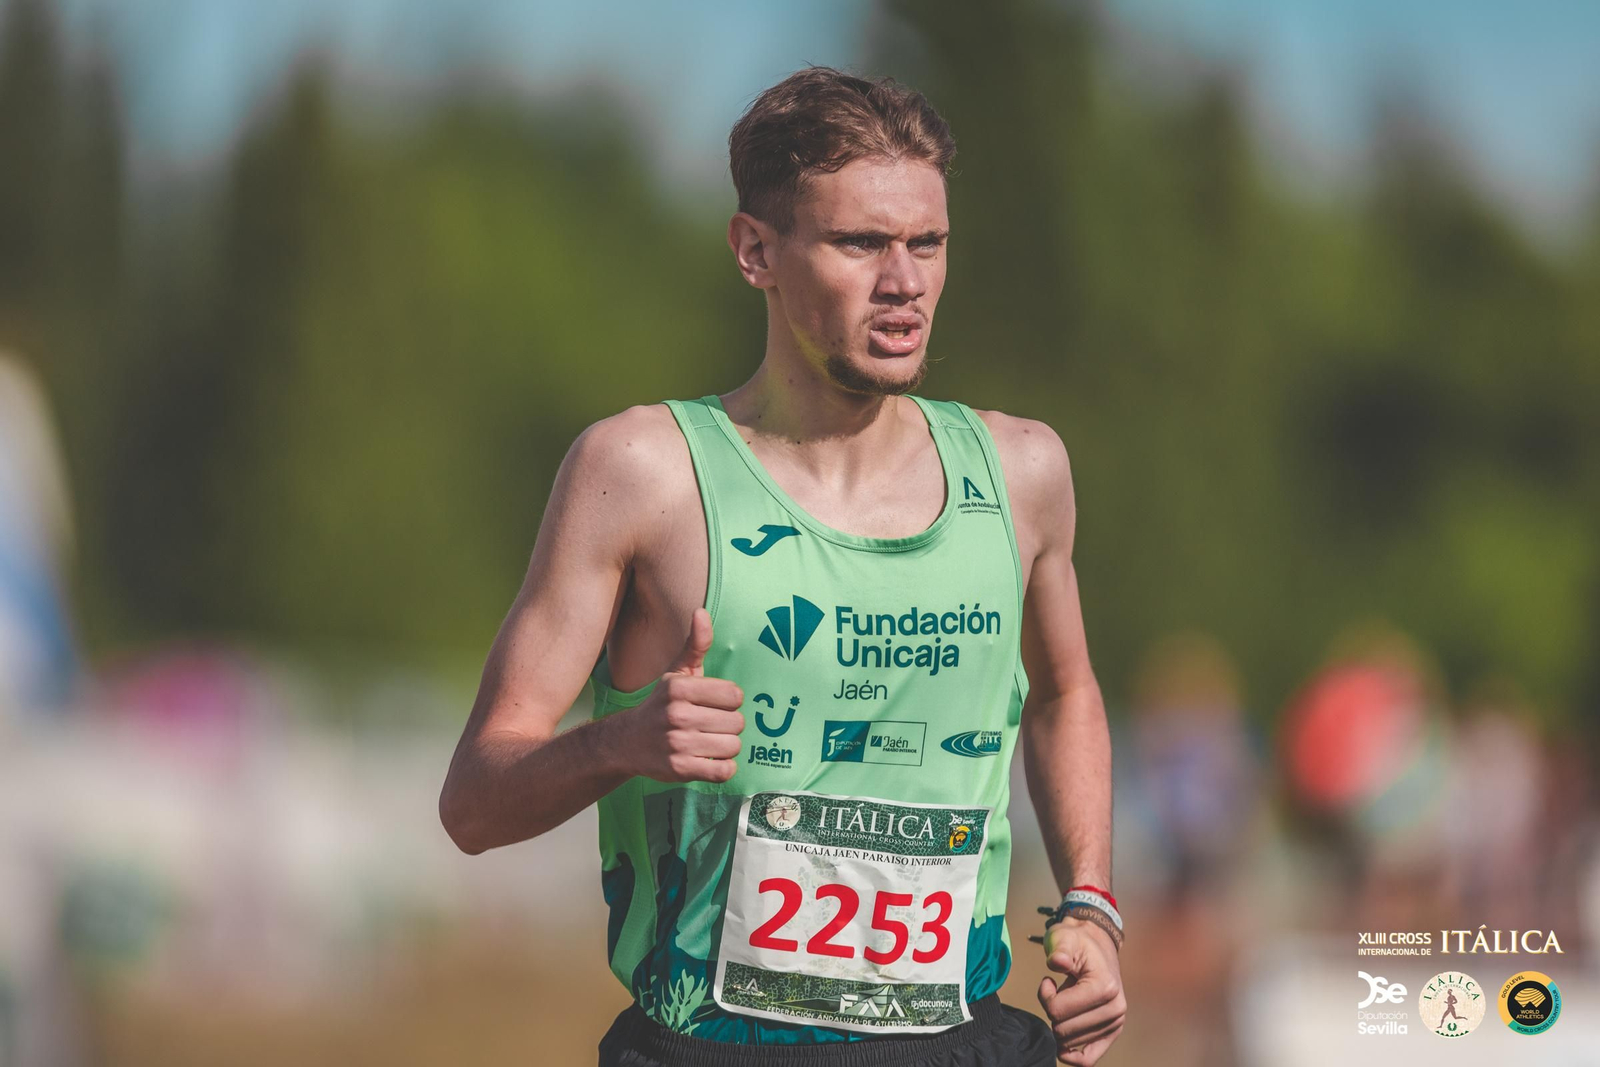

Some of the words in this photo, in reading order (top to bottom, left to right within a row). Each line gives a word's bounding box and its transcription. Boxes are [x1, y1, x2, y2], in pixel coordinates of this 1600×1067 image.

[835, 603, 1000, 636] Fundación
[837, 637, 960, 676] Unicaja
[833, 679, 888, 700] Jaén
[883, 736, 908, 748] Jaén
[818, 803, 935, 840] ITÁLICA
[818, 830, 876, 841] INTERNATIONAL
[879, 836, 902, 844] CROSS
[785, 843, 830, 857] UNICAJA
[833, 848, 859, 858] JAEN
[862, 851, 909, 866] PARAISO
[911, 857, 952, 866] INTERIOR
[749, 878, 953, 965] 2253
[767, 1006, 814, 1018] FEDERACIÓN
[816, 1013, 858, 1025] ANDALUZA
[875, 1019, 913, 1027] ATLETISMO
